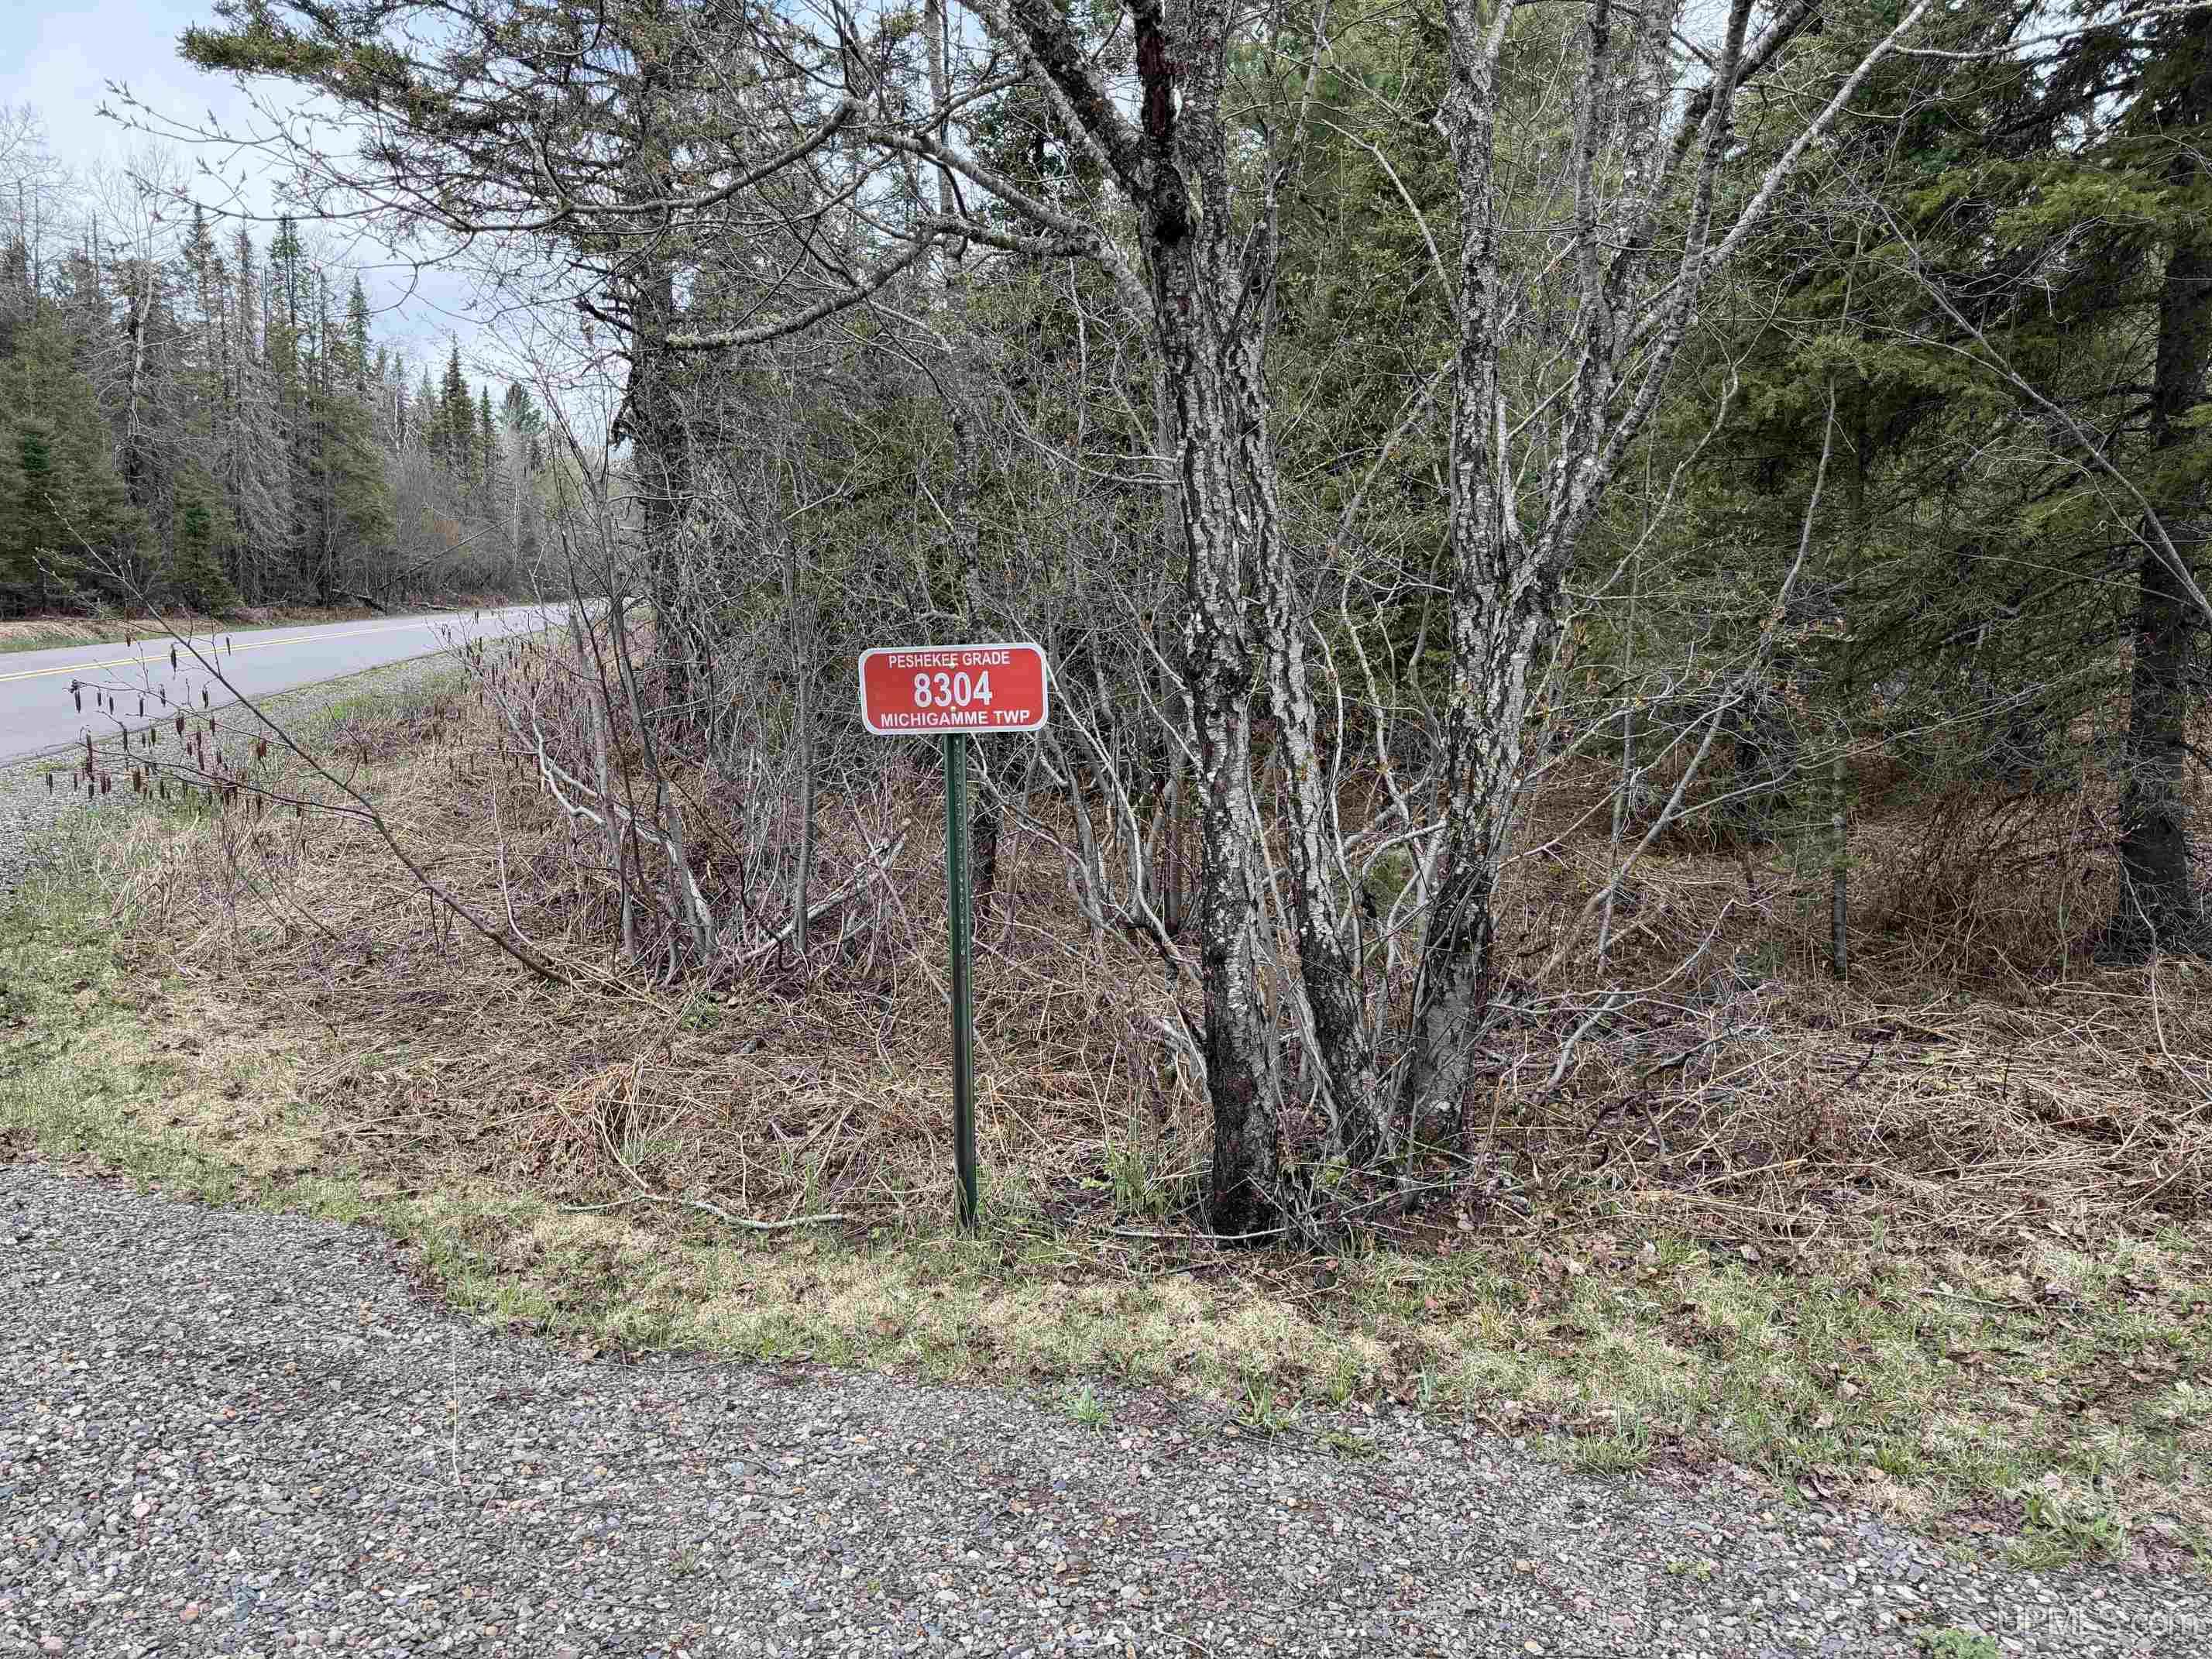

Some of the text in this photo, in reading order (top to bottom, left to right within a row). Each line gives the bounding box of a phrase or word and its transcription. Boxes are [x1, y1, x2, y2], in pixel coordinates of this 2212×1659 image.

[888, 651, 1011, 668] PESHEKEE GRADE
[913, 671, 993, 707] 8304
[881, 709, 1030, 727] MICHIGAMME TWP
